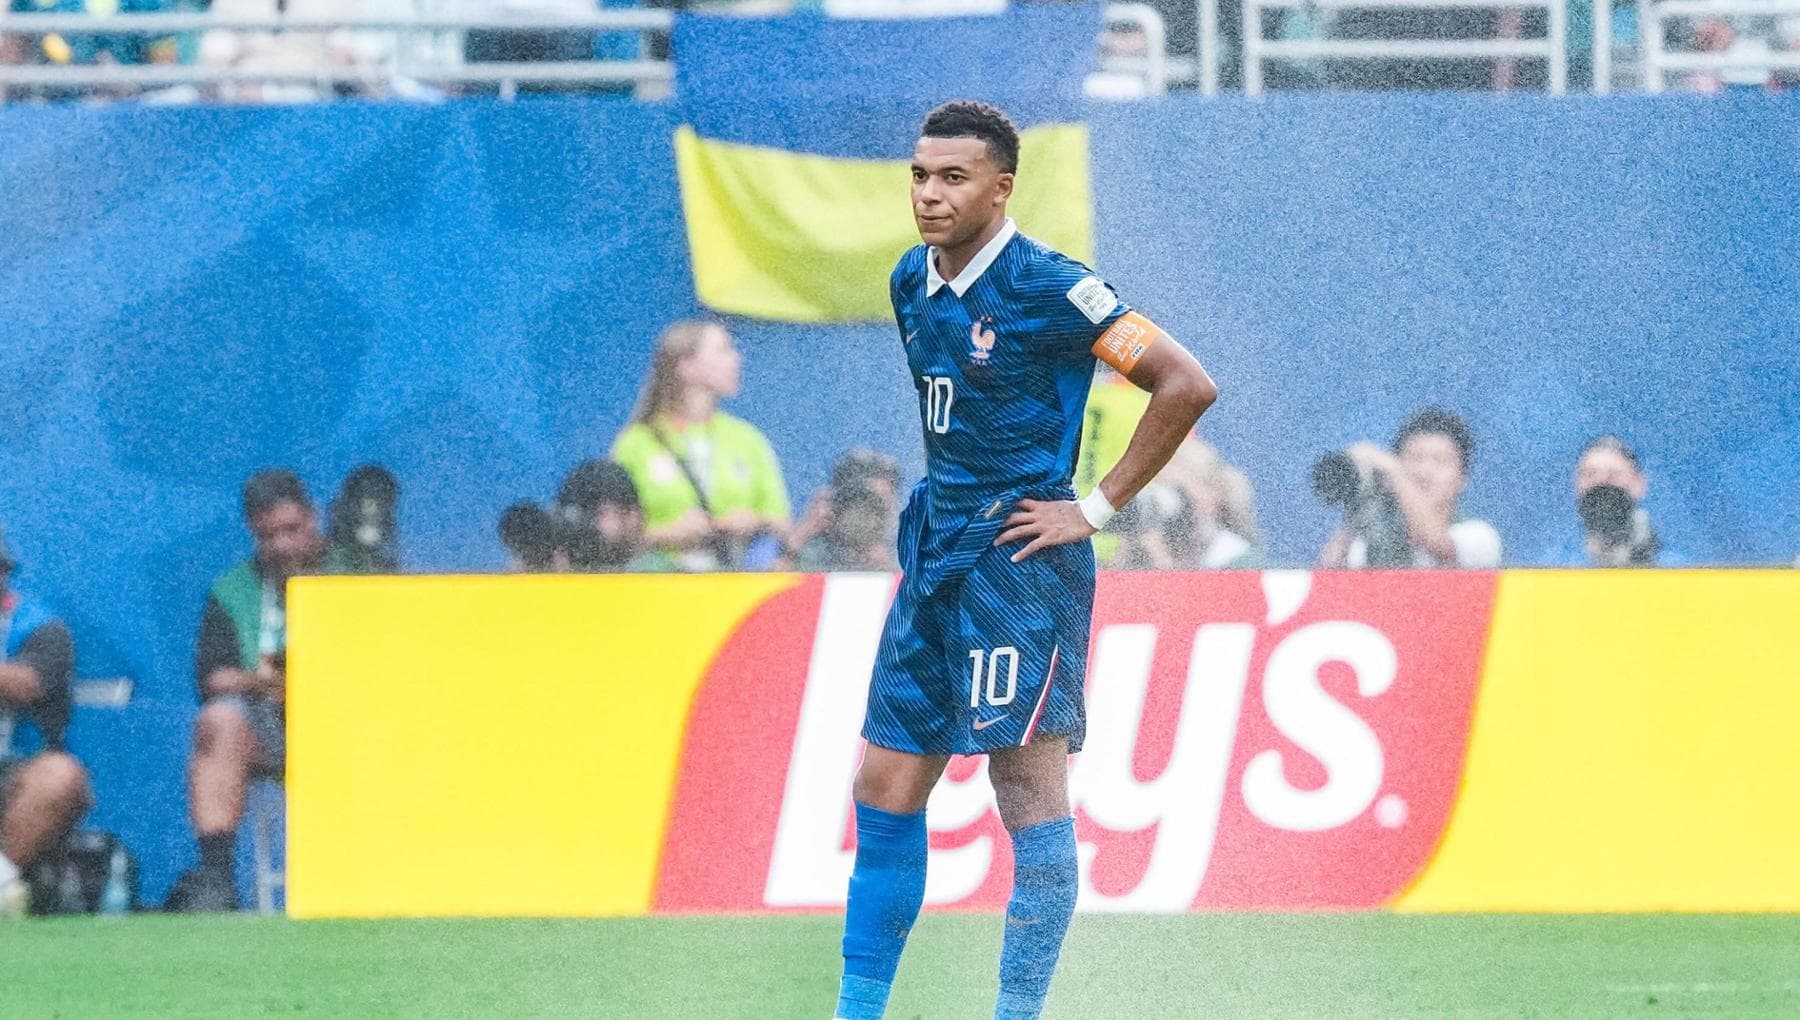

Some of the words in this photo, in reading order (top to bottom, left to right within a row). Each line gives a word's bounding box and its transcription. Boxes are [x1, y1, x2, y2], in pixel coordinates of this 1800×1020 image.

[1108, 321, 1137, 354] UNITES
[921, 375, 954, 434] 10
[968, 646, 1020, 708] 10
[762, 571, 1397, 913] Ly's
